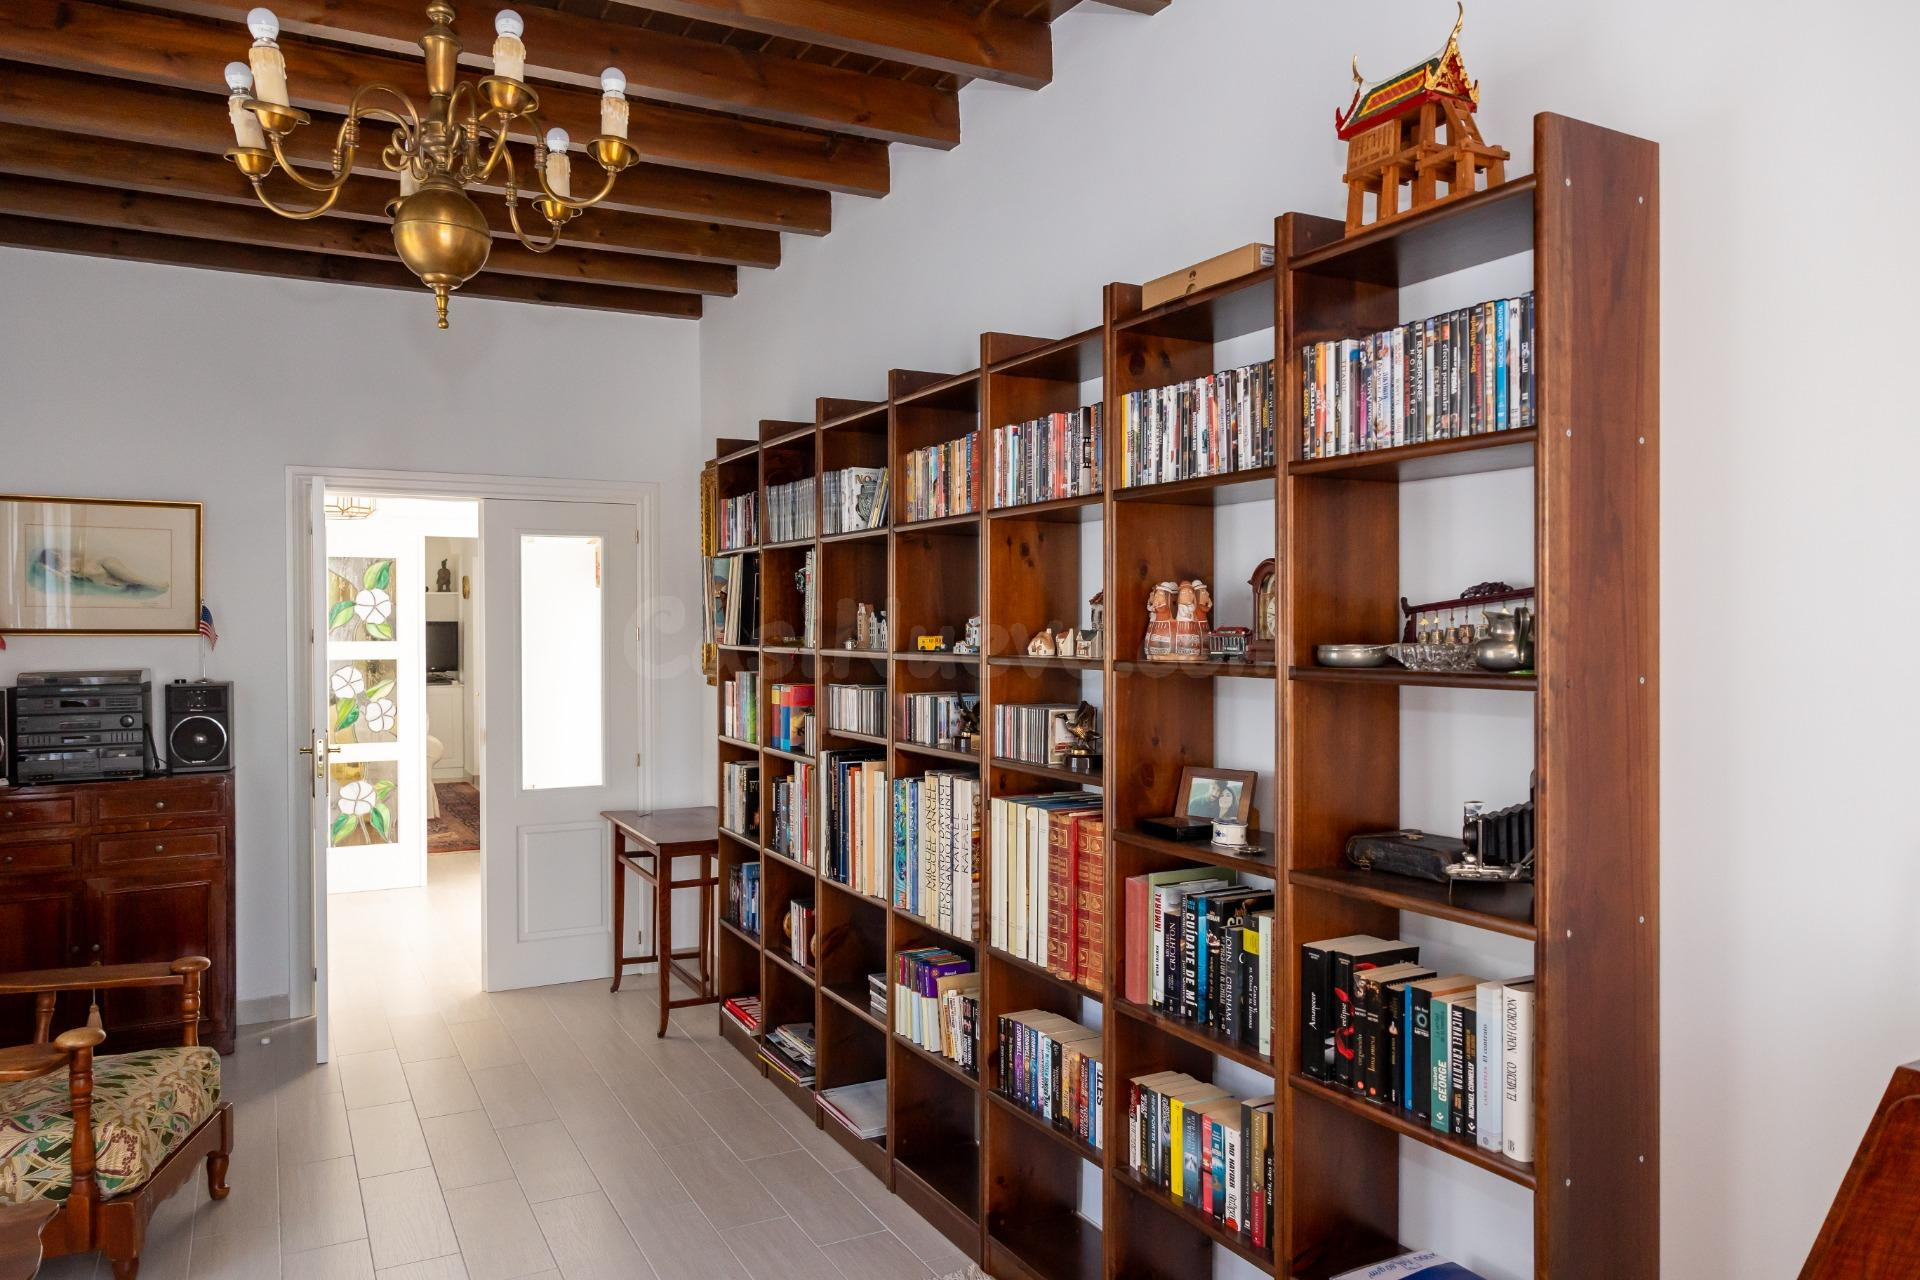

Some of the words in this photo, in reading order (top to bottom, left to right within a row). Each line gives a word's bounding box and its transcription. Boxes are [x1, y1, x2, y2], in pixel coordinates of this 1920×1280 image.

[1154, 893, 1162, 933] INMORAL
[1186, 912, 1198, 964] CUÍDATE
[1186, 969, 1195, 986] DE
[1186, 989, 1198, 1007] MÍ
[1309, 991, 1320, 1030] Amanecer
[1341, 1002, 1350, 1027] eclipse
[1506, 996, 1518, 1031] GORDON
[1452, 1010, 1463, 1046] MICHAEL
[1507, 1031, 1517, 1054] NOAH
[1438, 1060, 1447, 1103] GEORGE
[1452, 1048, 1463, 1090] CRICHTON
[1467, 1061, 1475, 1093] CONNELLY
[1467, 1093, 1475, 1119] MICHAEL
[1228, 1142, 1235, 1157] MO
